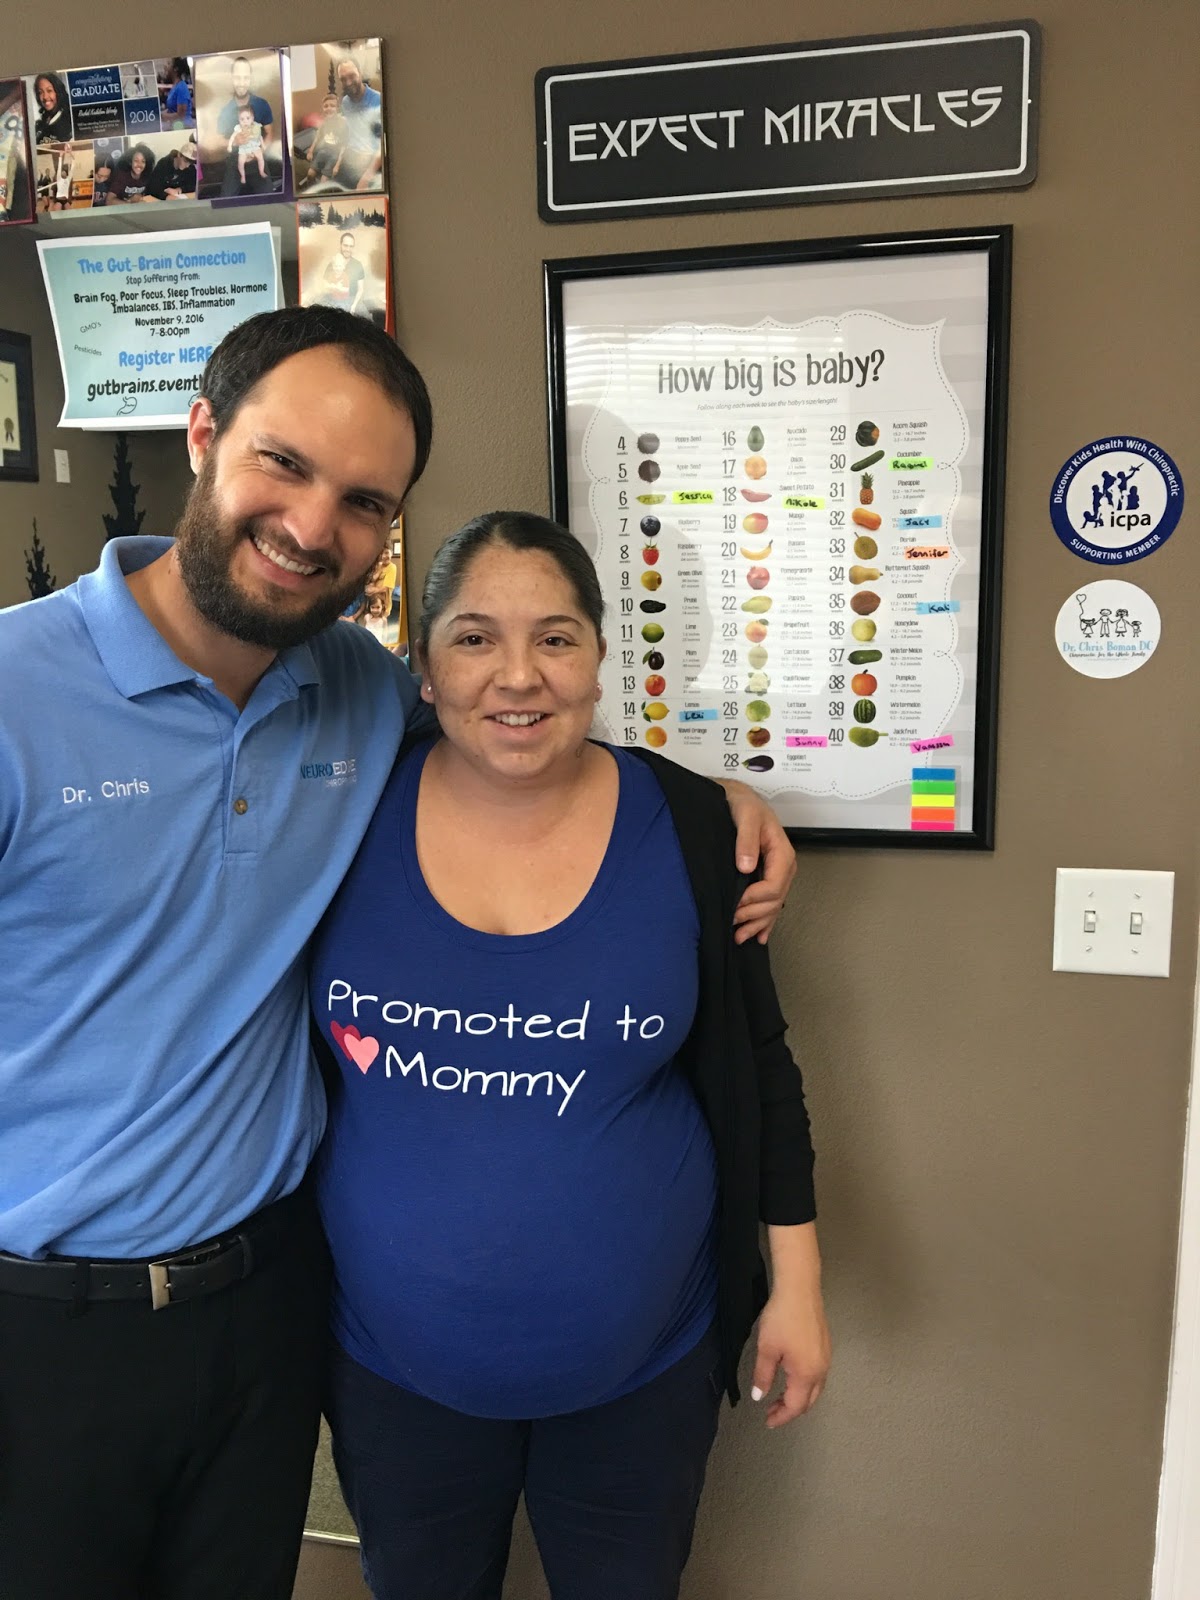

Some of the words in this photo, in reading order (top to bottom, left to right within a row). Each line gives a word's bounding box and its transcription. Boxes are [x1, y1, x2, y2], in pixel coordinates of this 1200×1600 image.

[71, 83, 120, 97] GRADUATE
[129, 110, 156, 123] 2016
[569, 110, 744, 162] EXPECT
[764, 86, 1002, 144] MIRACLES
[77, 258, 104, 274] The
[107, 255, 172, 273] Gut-Brain
[176, 250, 246, 268] Connection
[126, 276, 142, 286] Stop
[144, 272, 178, 284] Suffering
[180, 272, 200, 281] From:
[74, 293, 98, 303] Brain
[100, 292, 118, 304] Fog,
[120, 291, 139, 301] Poor
[141, 290, 166, 299] Focus,
[168, 288, 188, 299] Sleep
[191, 285, 229, 296] Troubles,
[230, 284, 268, 294] Hormone
[111, 302, 161, 314] Imbalances,
[163, 300, 178, 311] IBS,
[180, 297, 235, 309] Inflammation
[80, 322, 102, 333] GMO's
[135, 316, 174, 326] November
[185, 314, 204, 324] 2016
[150, 327, 190, 338] 7-8:00pm
[74, 344, 102, 356] Pesticides
[119, 350, 175, 371] Register
[658, 363, 715, 394] How
[724, 357, 763, 396] big
[773, 356, 796, 387] is
[806, 349, 885, 388] baby?
[722, 431, 736, 446] 16
[830, 425, 846, 441] 29
[618, 436, 626, 451] 4
[722, 459, 736, 474] 17
[830, 454, 846, 470] 30
[618, 463, 627, 478] 5
[1054, 465, 1074, 503] Discover
[1071, 450, 1092, 467] Kids
[1092, 439, 1123, 453] Health
[1126, 439, 1147, 453] With
[1148, 448, 1179, 496] Chiropractic
[722, 487, 737, 502] 18
[830, 482, 844, 498] 31
[619, 491, 628, 506] 6
[620, 518, 628, 532] 7
[723, 514, 736, 530] 19
[830, 511, 845, 526] 32
[1110, 511, 1151, 531] icpa
[620, 545, 629, 559] 8
[721, 542, 737, 557] 20
[829, 538, 845, 554] 33
[907, 549, 947, 558] Jennifer
[1070, 538, 1122, 560] SUPPORTING
[1125, 534, 1161, 558] MEMBER
[622, 571, 629, 586] 9
[721, 569, 735, 583] 21
[829, 566, 845, 581] 34
[620, 598, 633, 612] 10
[722, 596, 737, 611] 22
[829, 593, 845, 609] 35
[621, 624, 633, 639] 11
[722, 623, 738, 637] 23
[829, 621, 845, 636] 36
[1062, 642, 1076, 652] Dr.
[1078, 641, 1103, 651] Chris
[1107, 641, 1136, 651] Boman
[1140, 640, 1153, 650] DC
[622, 650, 635, 664] 12
[722, 649, 737, 664] 24
[829, 648, 845, 662] 37
[622, 676, 635, 690] 13
[722, 675, 738, 690] 25
[829, 675, 845, 690] 38
[623, 702, 636, 715] 14
[723, 702, 738, 716] 26
[829, 702, 844, 716] 39
[624, 727, 637, 741] 15
[723, 728, 738, 742] 27
[828, 728, 844, 742] 40
[724, 753, 740, 768] 28
[62, 787, 92, 804] Dr.
[101, 778, 149, 798] Chris
[328, 979, 590, 1040] Promoted
[616, 1004, 664, 1041] to
[386, 1045, 586, 1117] Mommy
